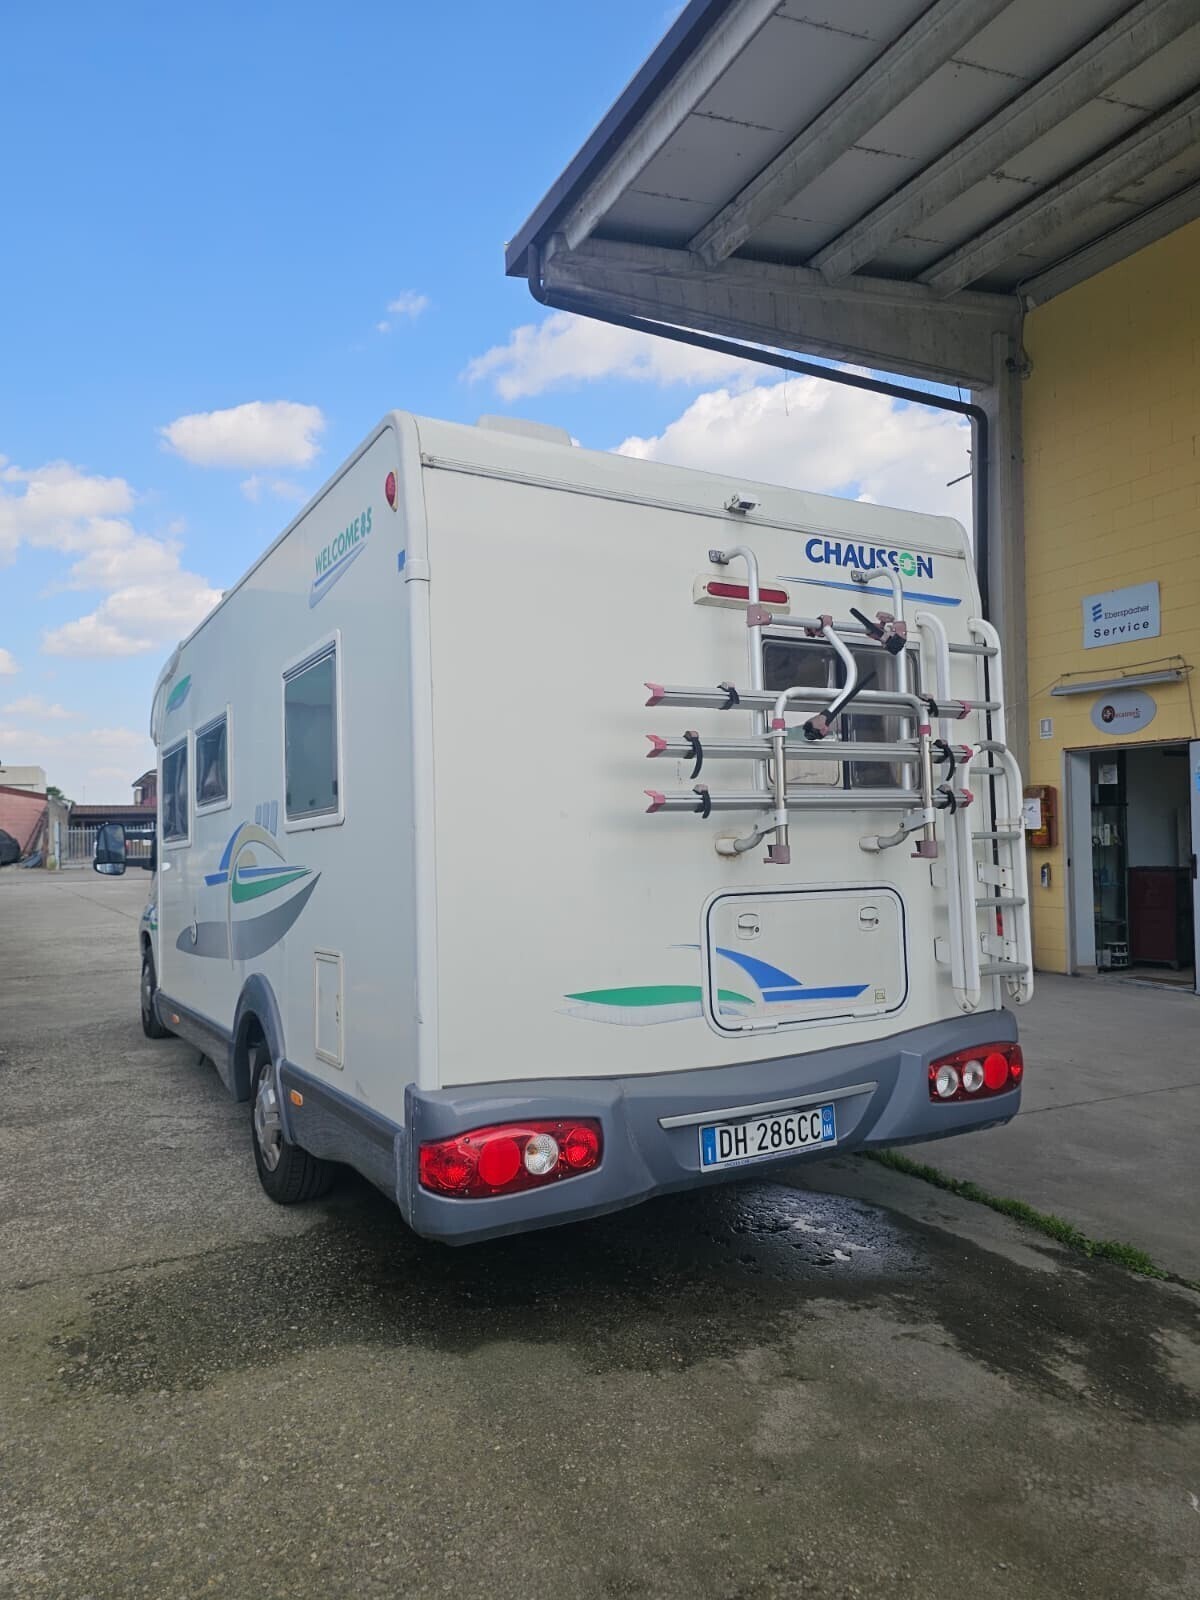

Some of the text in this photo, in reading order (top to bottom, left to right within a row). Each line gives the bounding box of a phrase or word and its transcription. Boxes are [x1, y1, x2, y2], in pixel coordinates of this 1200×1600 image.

[315, 506, 372, 576] WELCOME 85
[805, 538, 933, 579] CHAUSSON
[1094, 620, 1150, 638] Service
[719, 1126, 748, 1158] DH
[757, 1112, 821, 1151] 286CC
